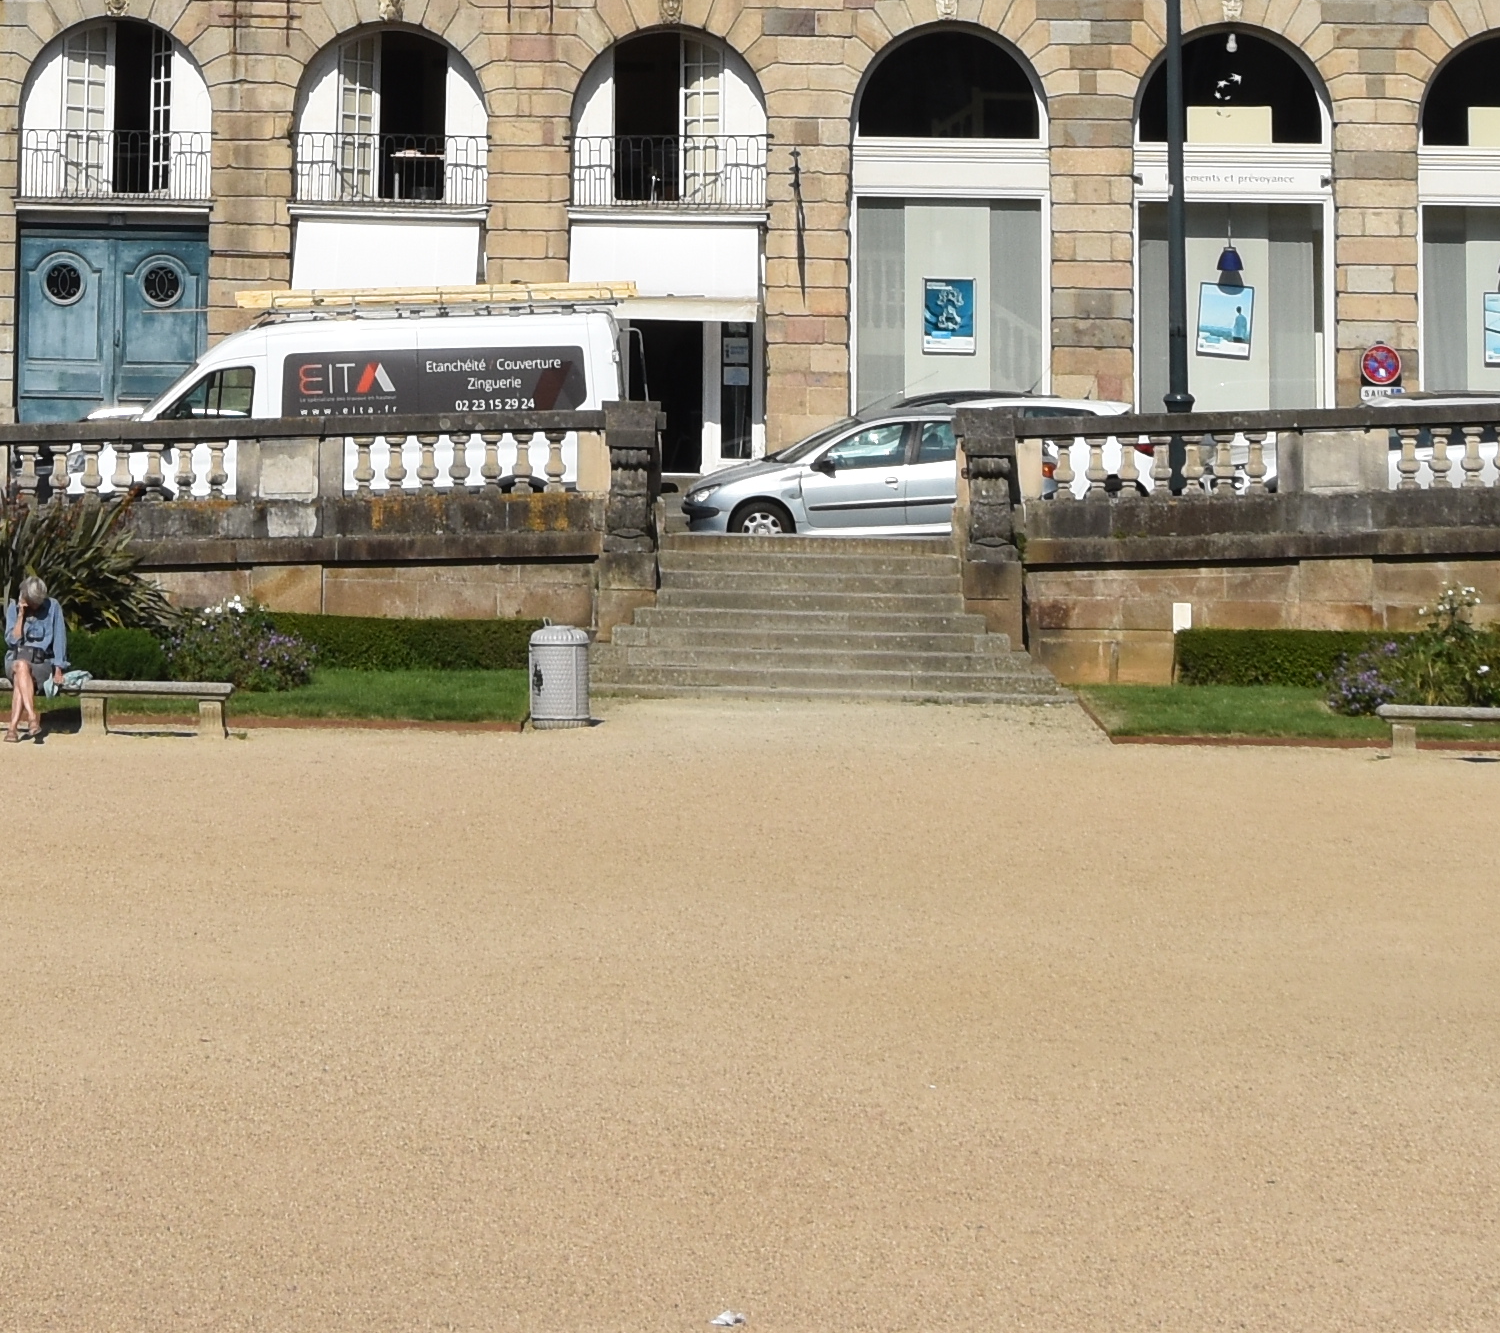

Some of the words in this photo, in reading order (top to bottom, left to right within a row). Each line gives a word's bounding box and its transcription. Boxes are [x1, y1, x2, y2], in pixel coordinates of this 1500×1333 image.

[1224, 175, 1234, 183] et
[1238, 174, 1295, 185] prévoyance
[426, 358, 486, 373] Etanchéité
[496, 358, 561, 371] Couverture
[299, 362, 396, 395] EITA
[467, 376, 522, 392] Zinguerie
[455, 400, 469, 411] 02
[472, 399, 486, 410] 23
[489, 399, 502, 410] 15
[504, 398, 519, 409] 29
[521, 398, 535, 409] 24
